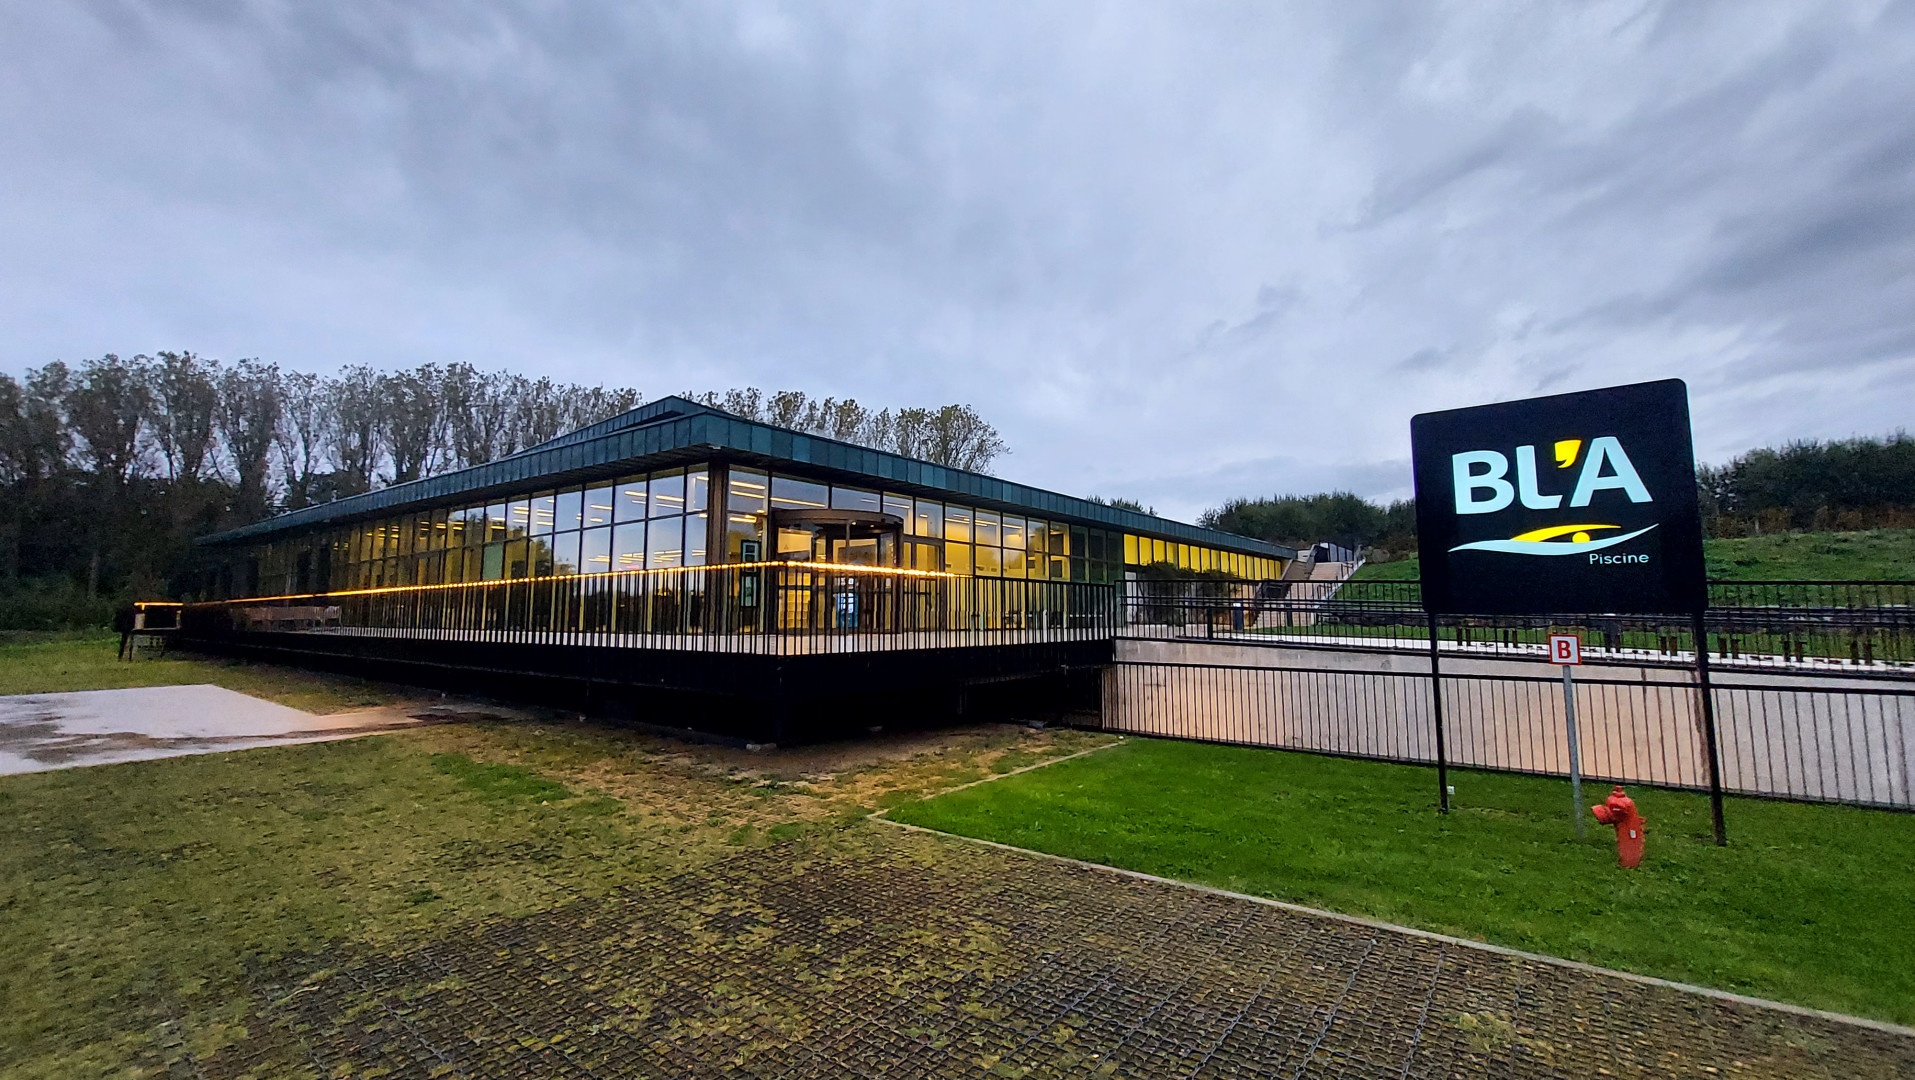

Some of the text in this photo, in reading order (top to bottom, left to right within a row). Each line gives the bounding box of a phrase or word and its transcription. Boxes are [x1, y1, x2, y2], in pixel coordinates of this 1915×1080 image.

[1452, 436, 1653, 514] BL'A
[1589, 553, 1650, 564] Piscine
[1557, 640, 1571, 659] B
